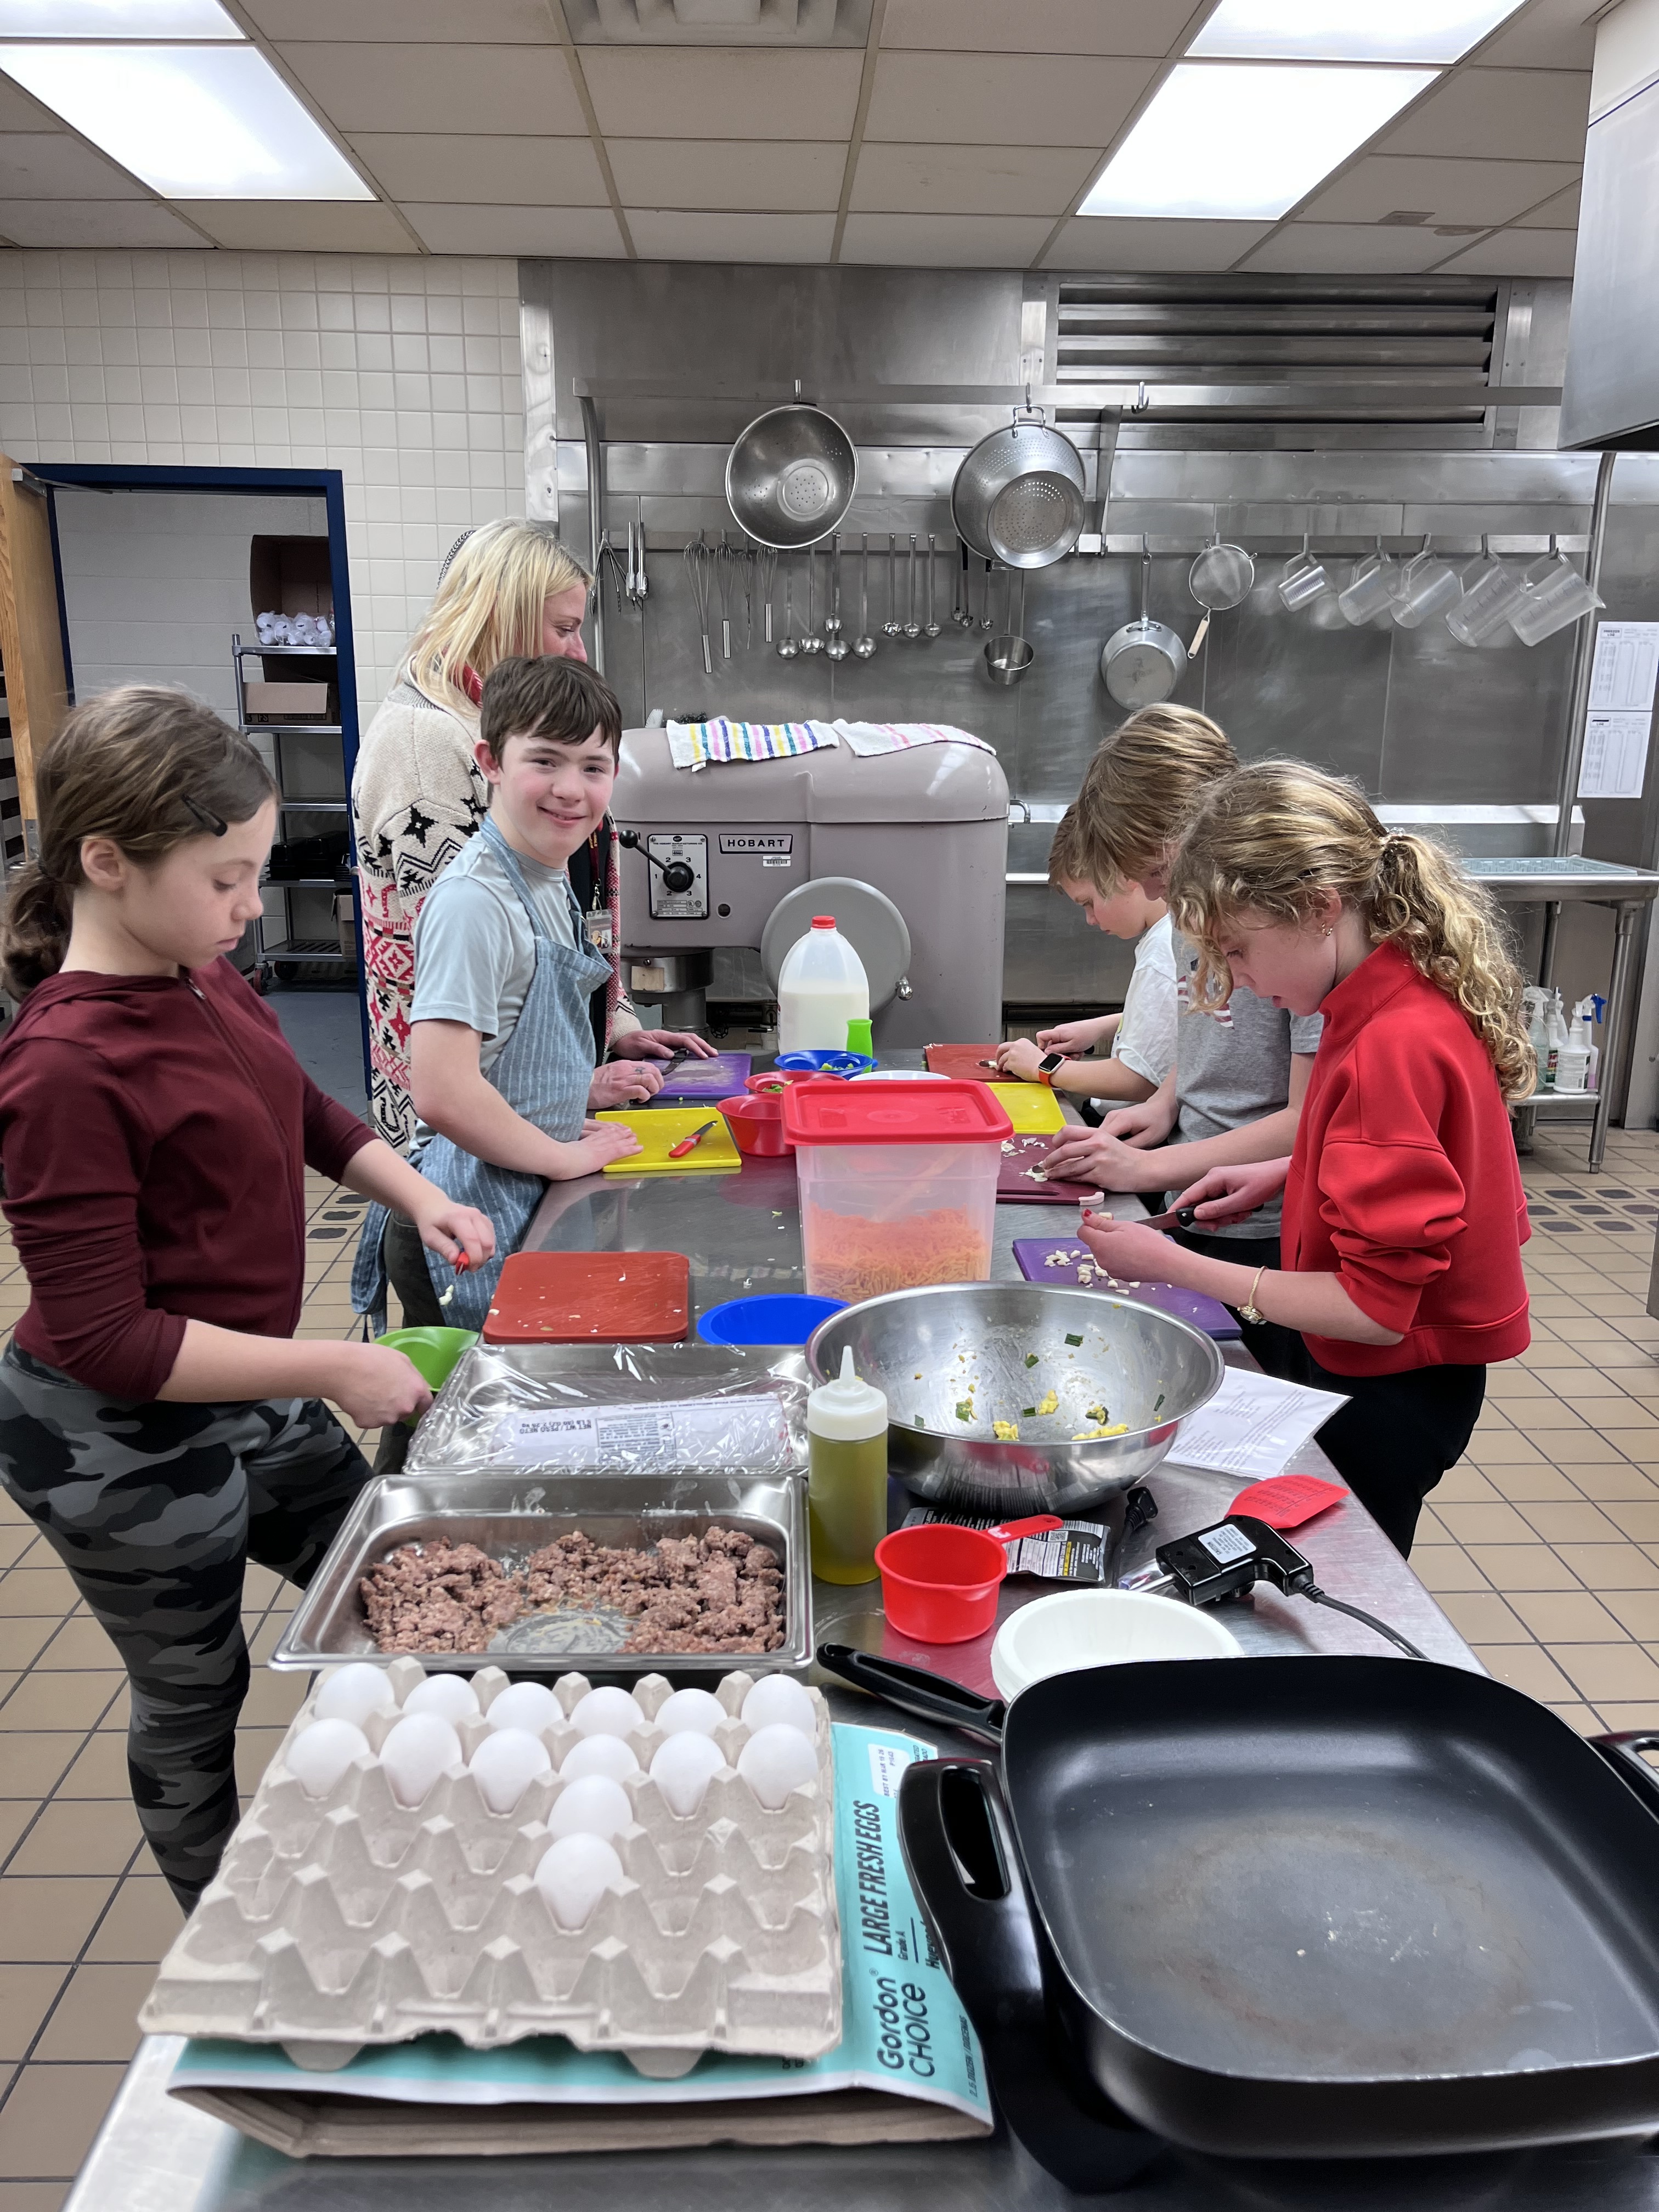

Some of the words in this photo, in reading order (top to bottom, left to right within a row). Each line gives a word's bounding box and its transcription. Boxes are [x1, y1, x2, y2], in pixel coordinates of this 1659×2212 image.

[727, 839, 785, 847] HOBART
[853, 1799, 882, 1842] EGGS
[856, 1839, 887, 1896] FRESH
[859, 1893, 893, 1956] LARGE
[872, 1976, 905, 2069] Gordon
